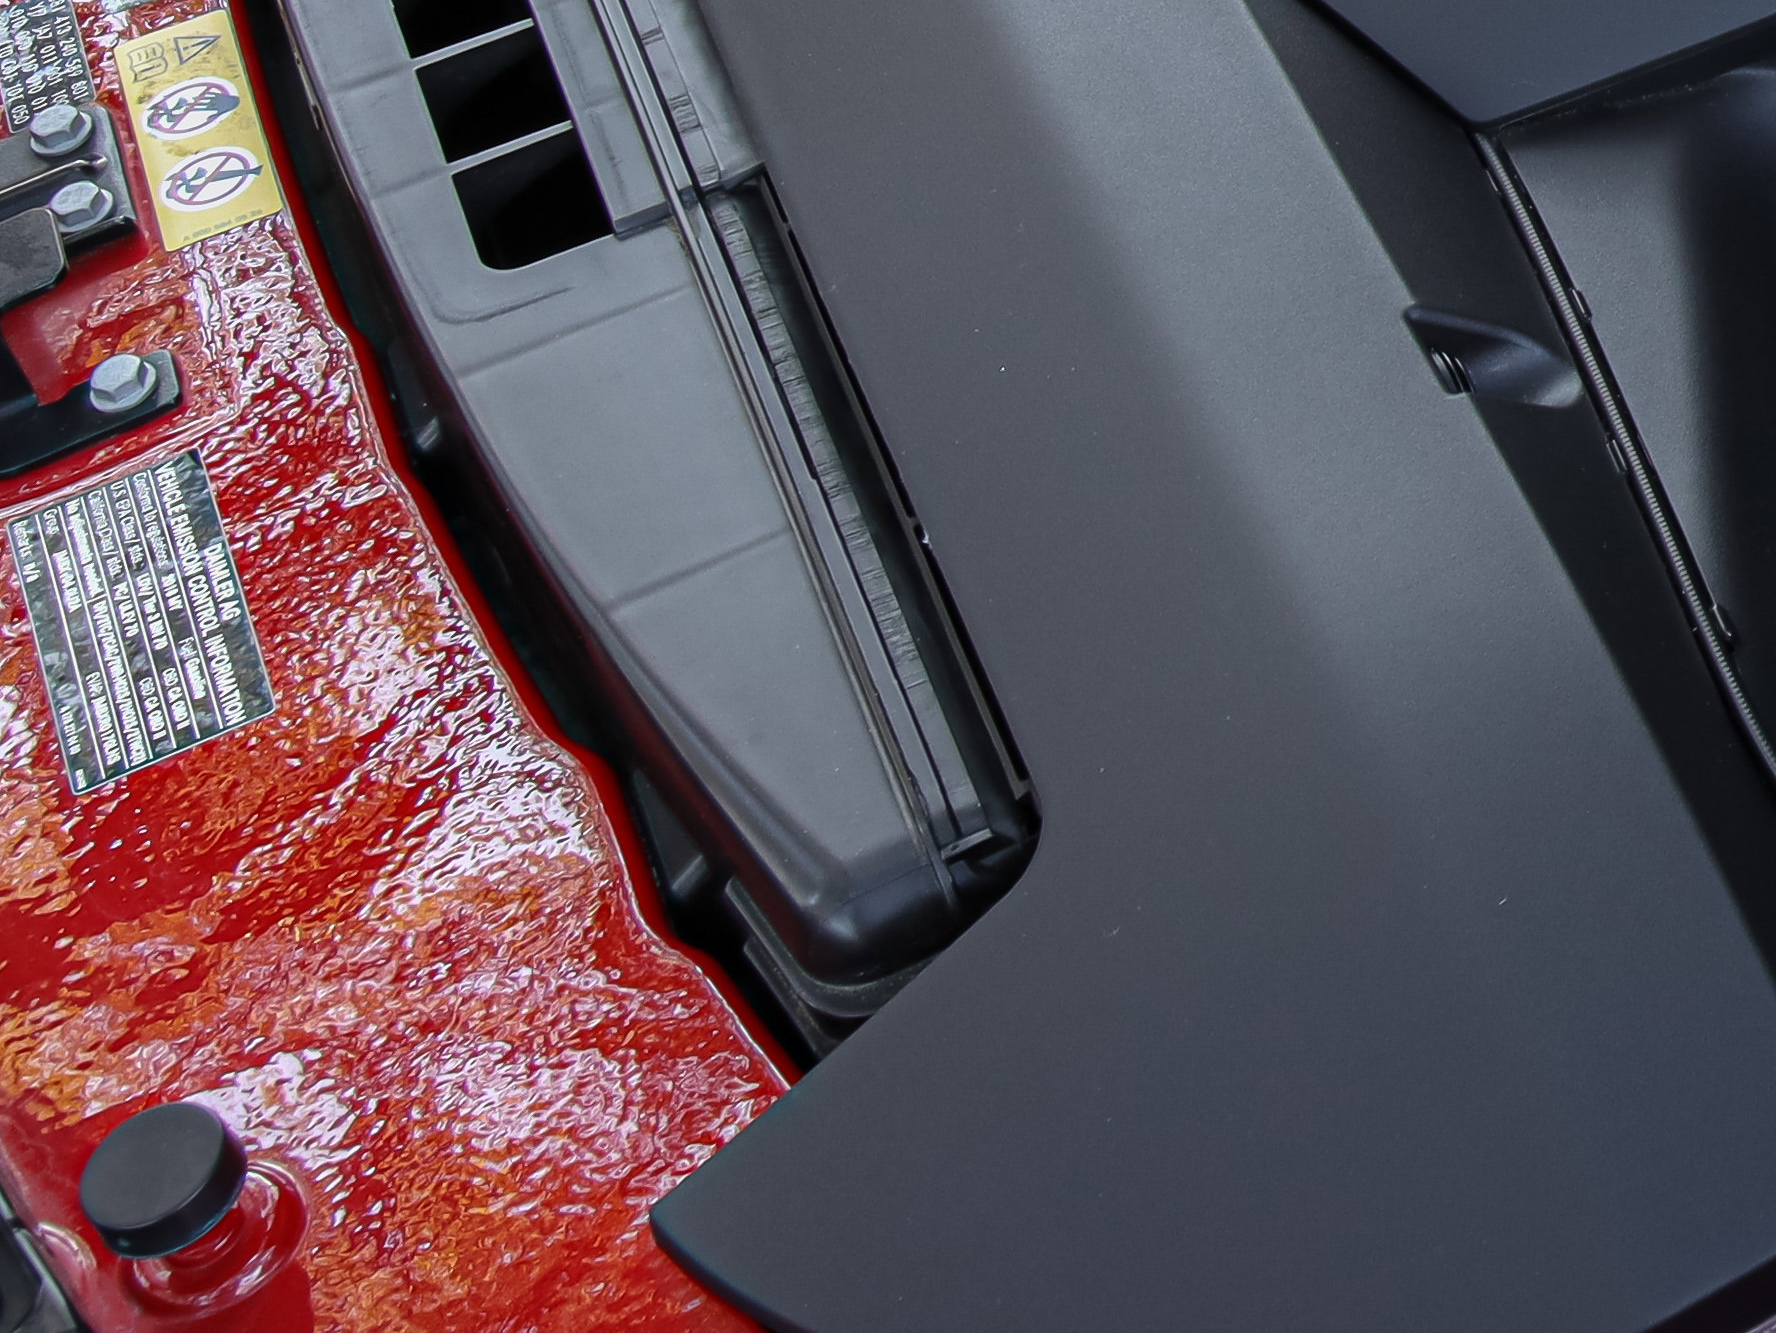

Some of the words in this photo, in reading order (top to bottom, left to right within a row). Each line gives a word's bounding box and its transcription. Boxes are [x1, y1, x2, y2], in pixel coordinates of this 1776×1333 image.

[114, 497, 132, 519] EPA
[153, 459, 187, 517] VEHICLE
[168, 511, 204, 577] EMISSION
[202, 541, 236, 602] DAIMLER
[185, 572, 221, 638] CONTROL
[218, 598, 242, 622] AG
[165, 593, 183, 612] MY
[182, 656, 209, 701] Gasoline
[164, 685, 184, 704] CA
[202, 632, 247, 727] INFORMATION
[141, 695, 160, 713] CA
[145, 708, 165, 733] OBD
[168, 699, 189, 724] OBD
